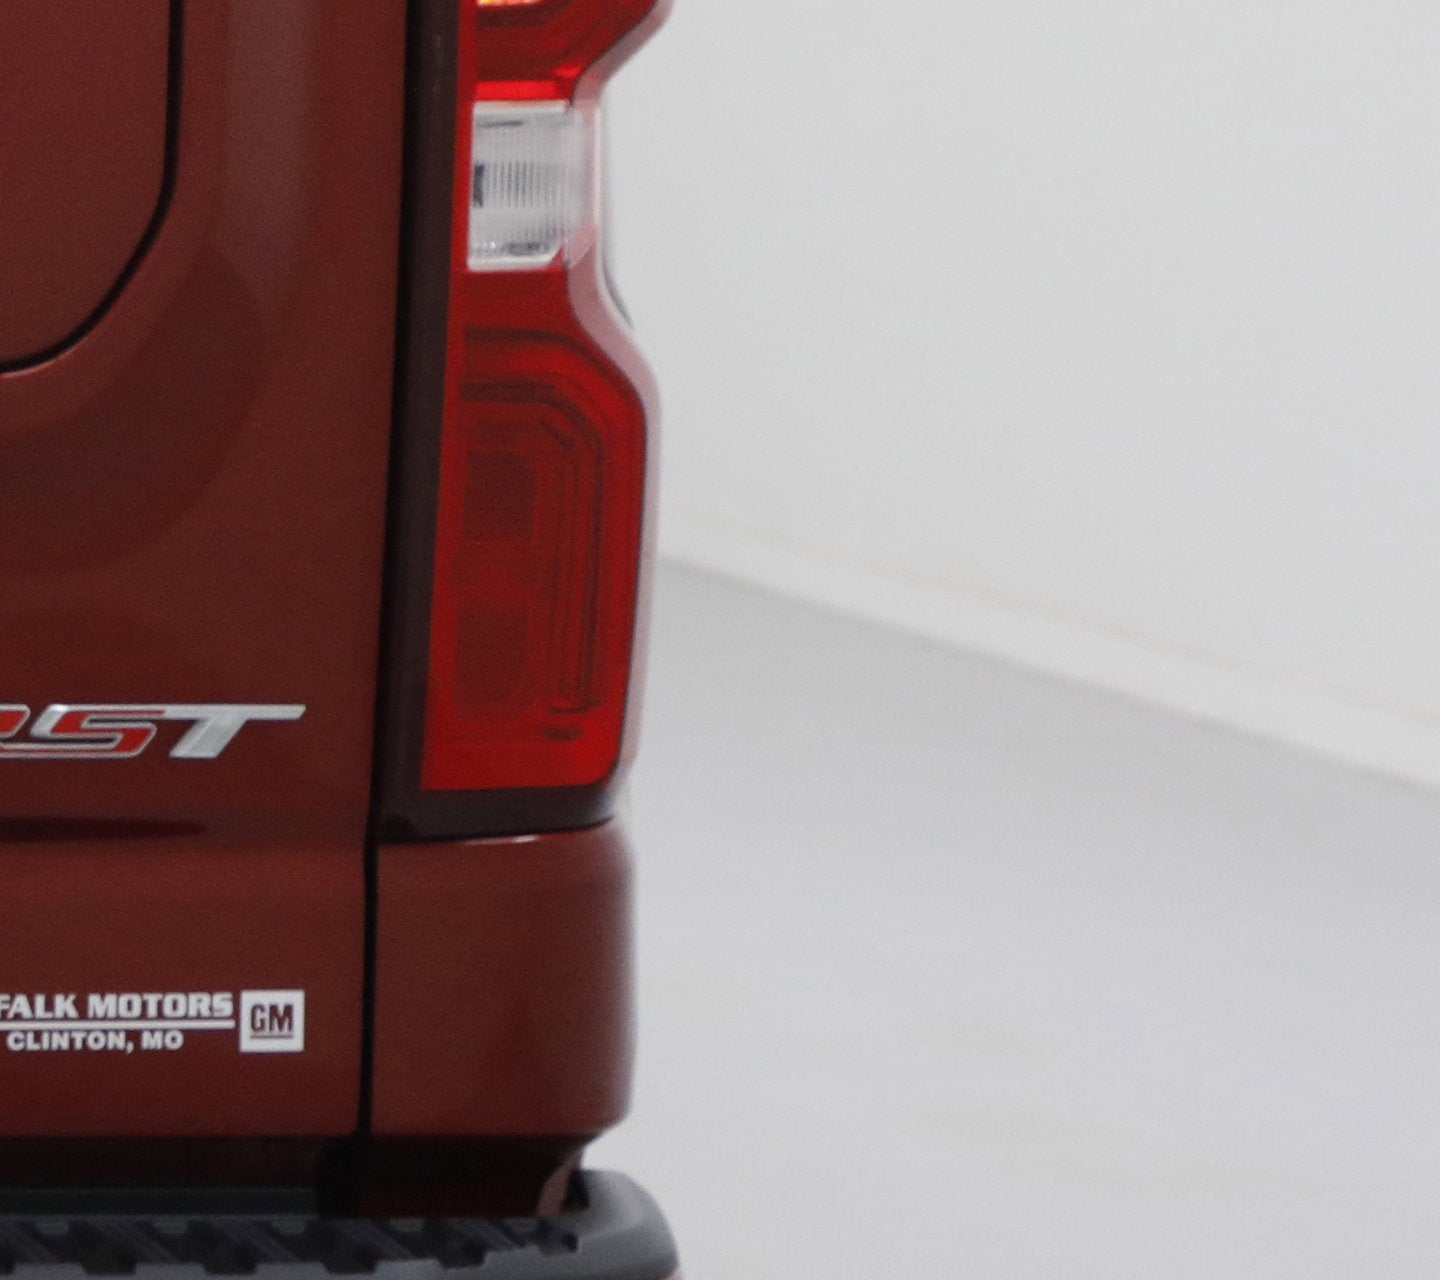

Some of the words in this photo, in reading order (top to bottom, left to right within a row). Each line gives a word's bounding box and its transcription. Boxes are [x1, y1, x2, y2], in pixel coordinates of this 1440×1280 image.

[87, 992, 234, 1019] MOTORS
[249, 1004, 295, 1034] GM
[6, 1031, 133, 1054] CLINTON,
[142, 1031, 184, 1051] MO
